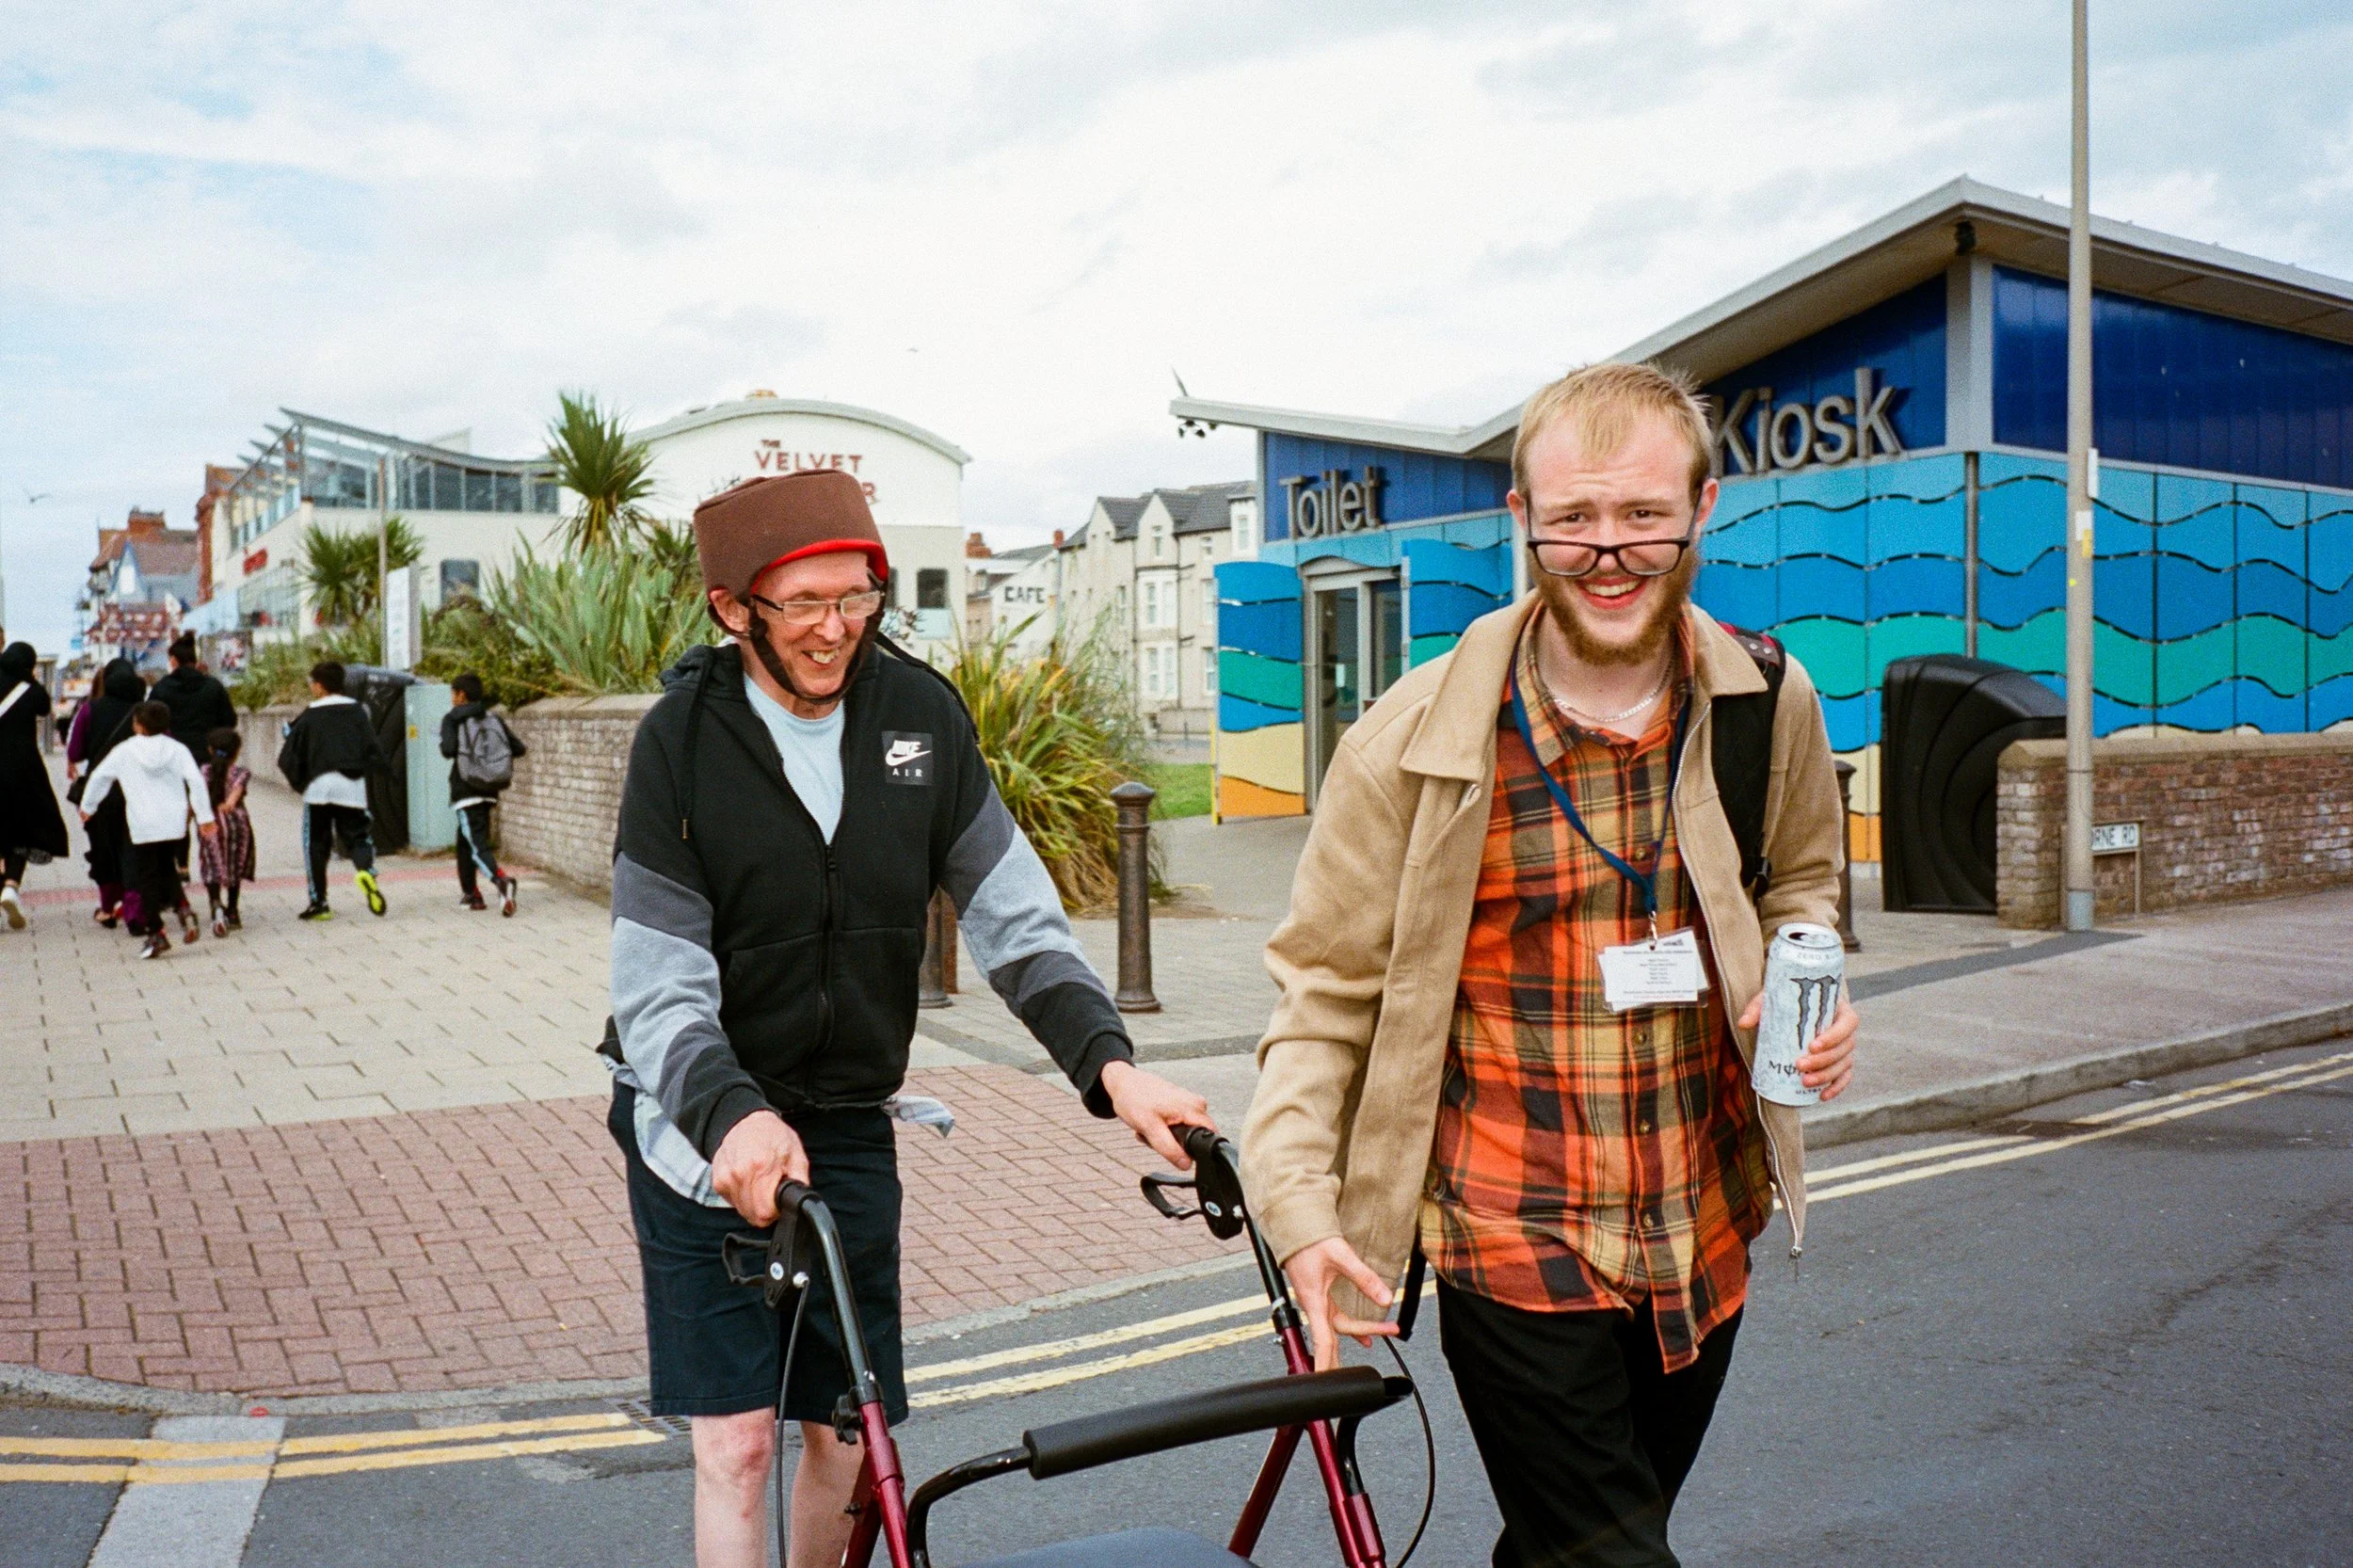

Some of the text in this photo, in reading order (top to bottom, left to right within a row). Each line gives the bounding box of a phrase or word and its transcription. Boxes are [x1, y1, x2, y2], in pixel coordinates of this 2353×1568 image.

[1707, 367, 1903, 478] Kiosk
[760, 439, 781, 448] THE
[755, 450, 863, 472] VELVET
[1278, 466, 1382, 540] Toilet
[1004, 586, 1045, 603] CAFE
[891, 740, 921, 755] NIKE
[892, 768, 922, 777] AIR
[2122, 824, 2136, 843] RD
[1769, 1060, 1800, 1078] MO
